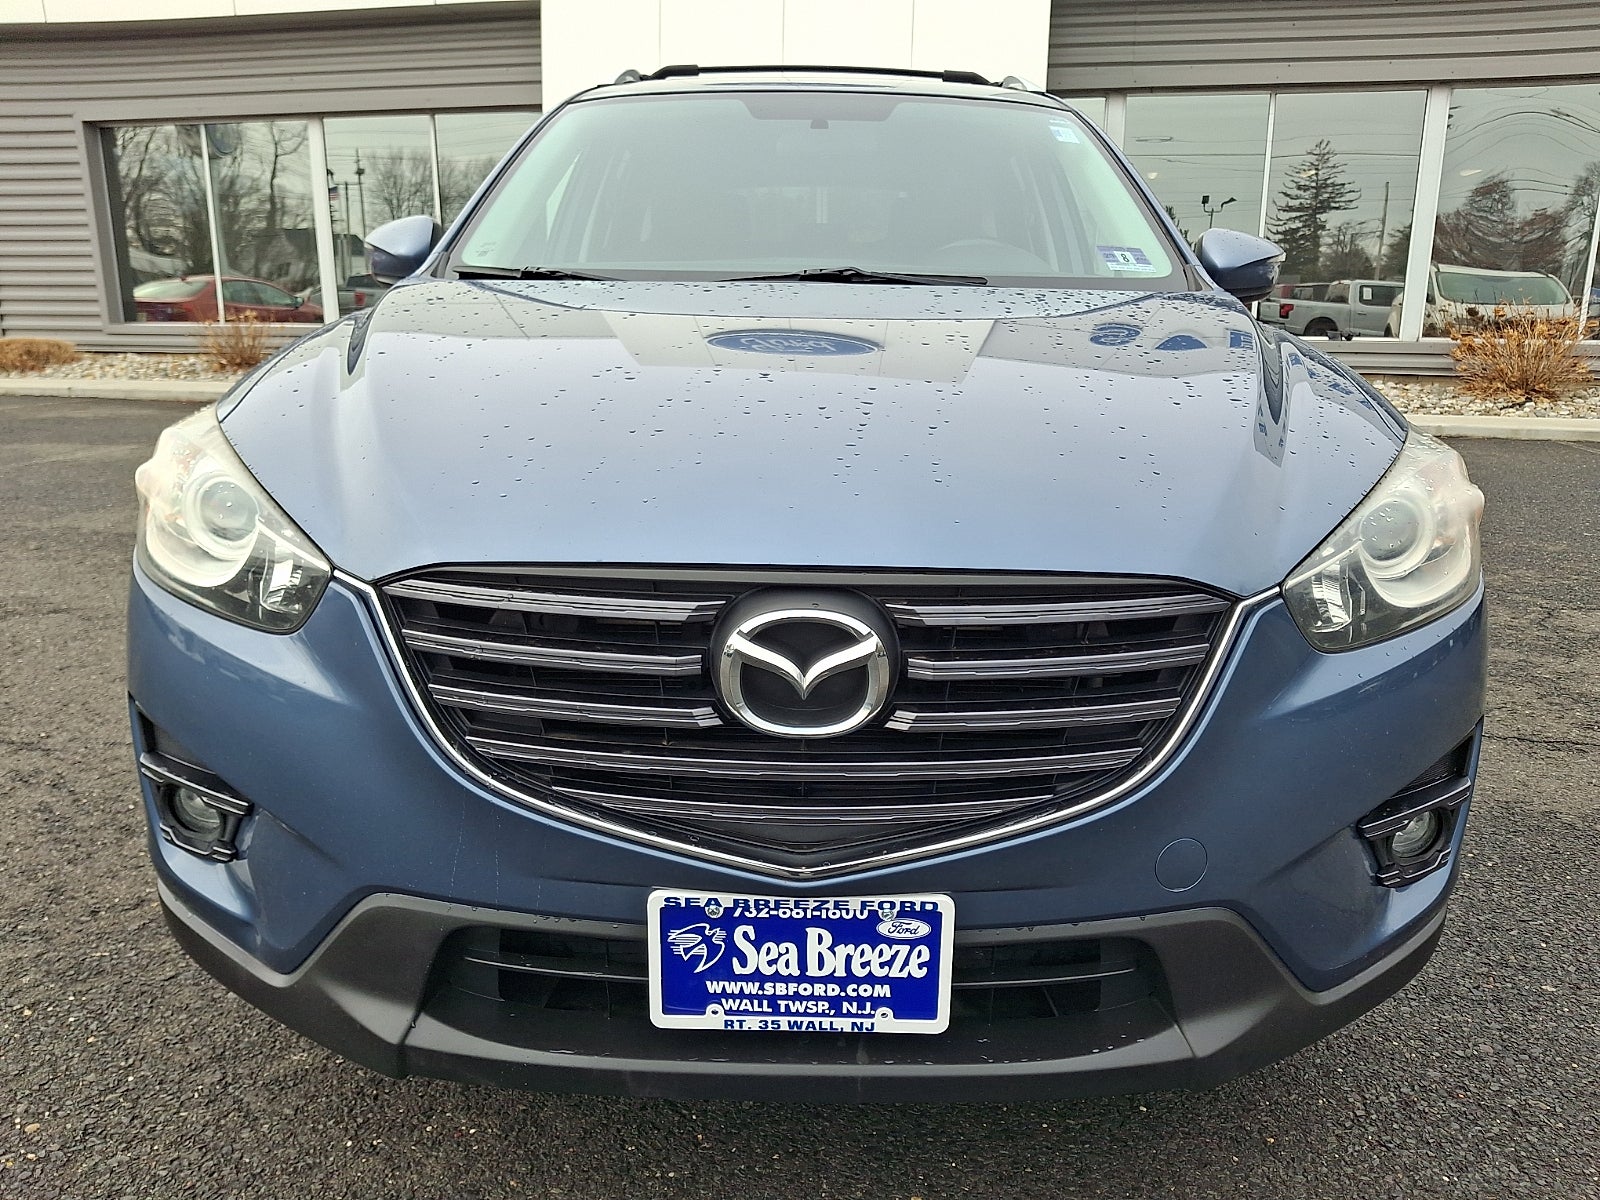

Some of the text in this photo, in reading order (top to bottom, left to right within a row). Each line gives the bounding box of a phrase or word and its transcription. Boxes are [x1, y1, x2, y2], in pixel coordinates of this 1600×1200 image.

[664, 897, 723, 908] SEA
[860, 900, 939, 911] FORD
[887, 921, 921, 935] Ford
[732, 924, 931, 978] Sea Breeze
[705, 980, 892, 998] WWW.SBFORD.COM
[721, 998, 773, 1012] WALL
[842, 1001, 876, 1015] N.J.
[724, 1019, 876, 1032] RT. 35 WALL, NJ
